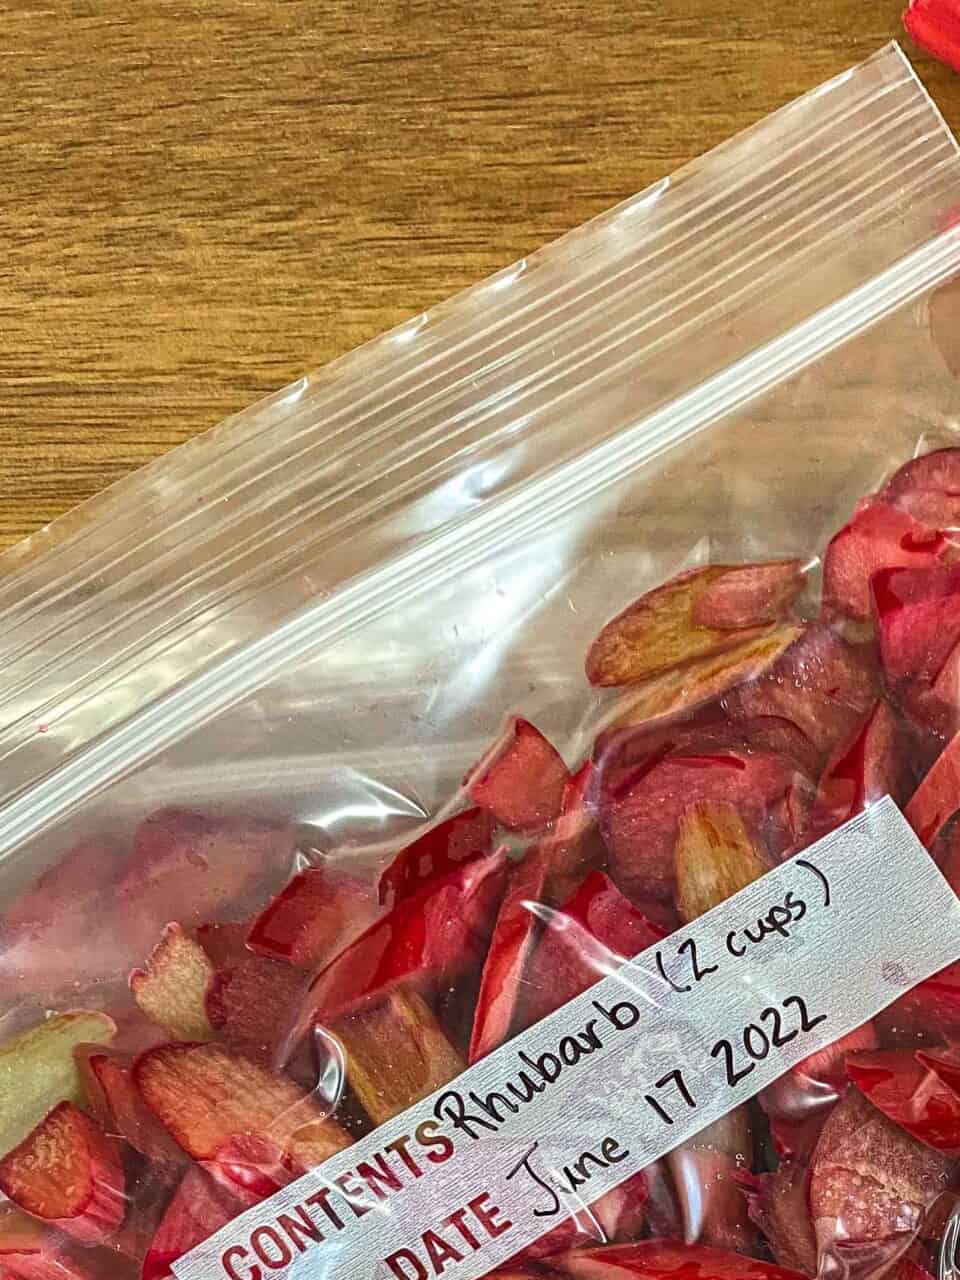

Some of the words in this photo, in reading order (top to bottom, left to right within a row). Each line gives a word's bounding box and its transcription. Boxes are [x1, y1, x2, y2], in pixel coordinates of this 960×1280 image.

[433, 1000, 640, 1140] Rhubarb
[655, 937, 719, 992] (2
[726, 858, 831, 957] cups)
[505, 1136, 630, 1218] June
[643, 1069, 697, 1125] 17
[711, 995, 828, 1088] 2022
